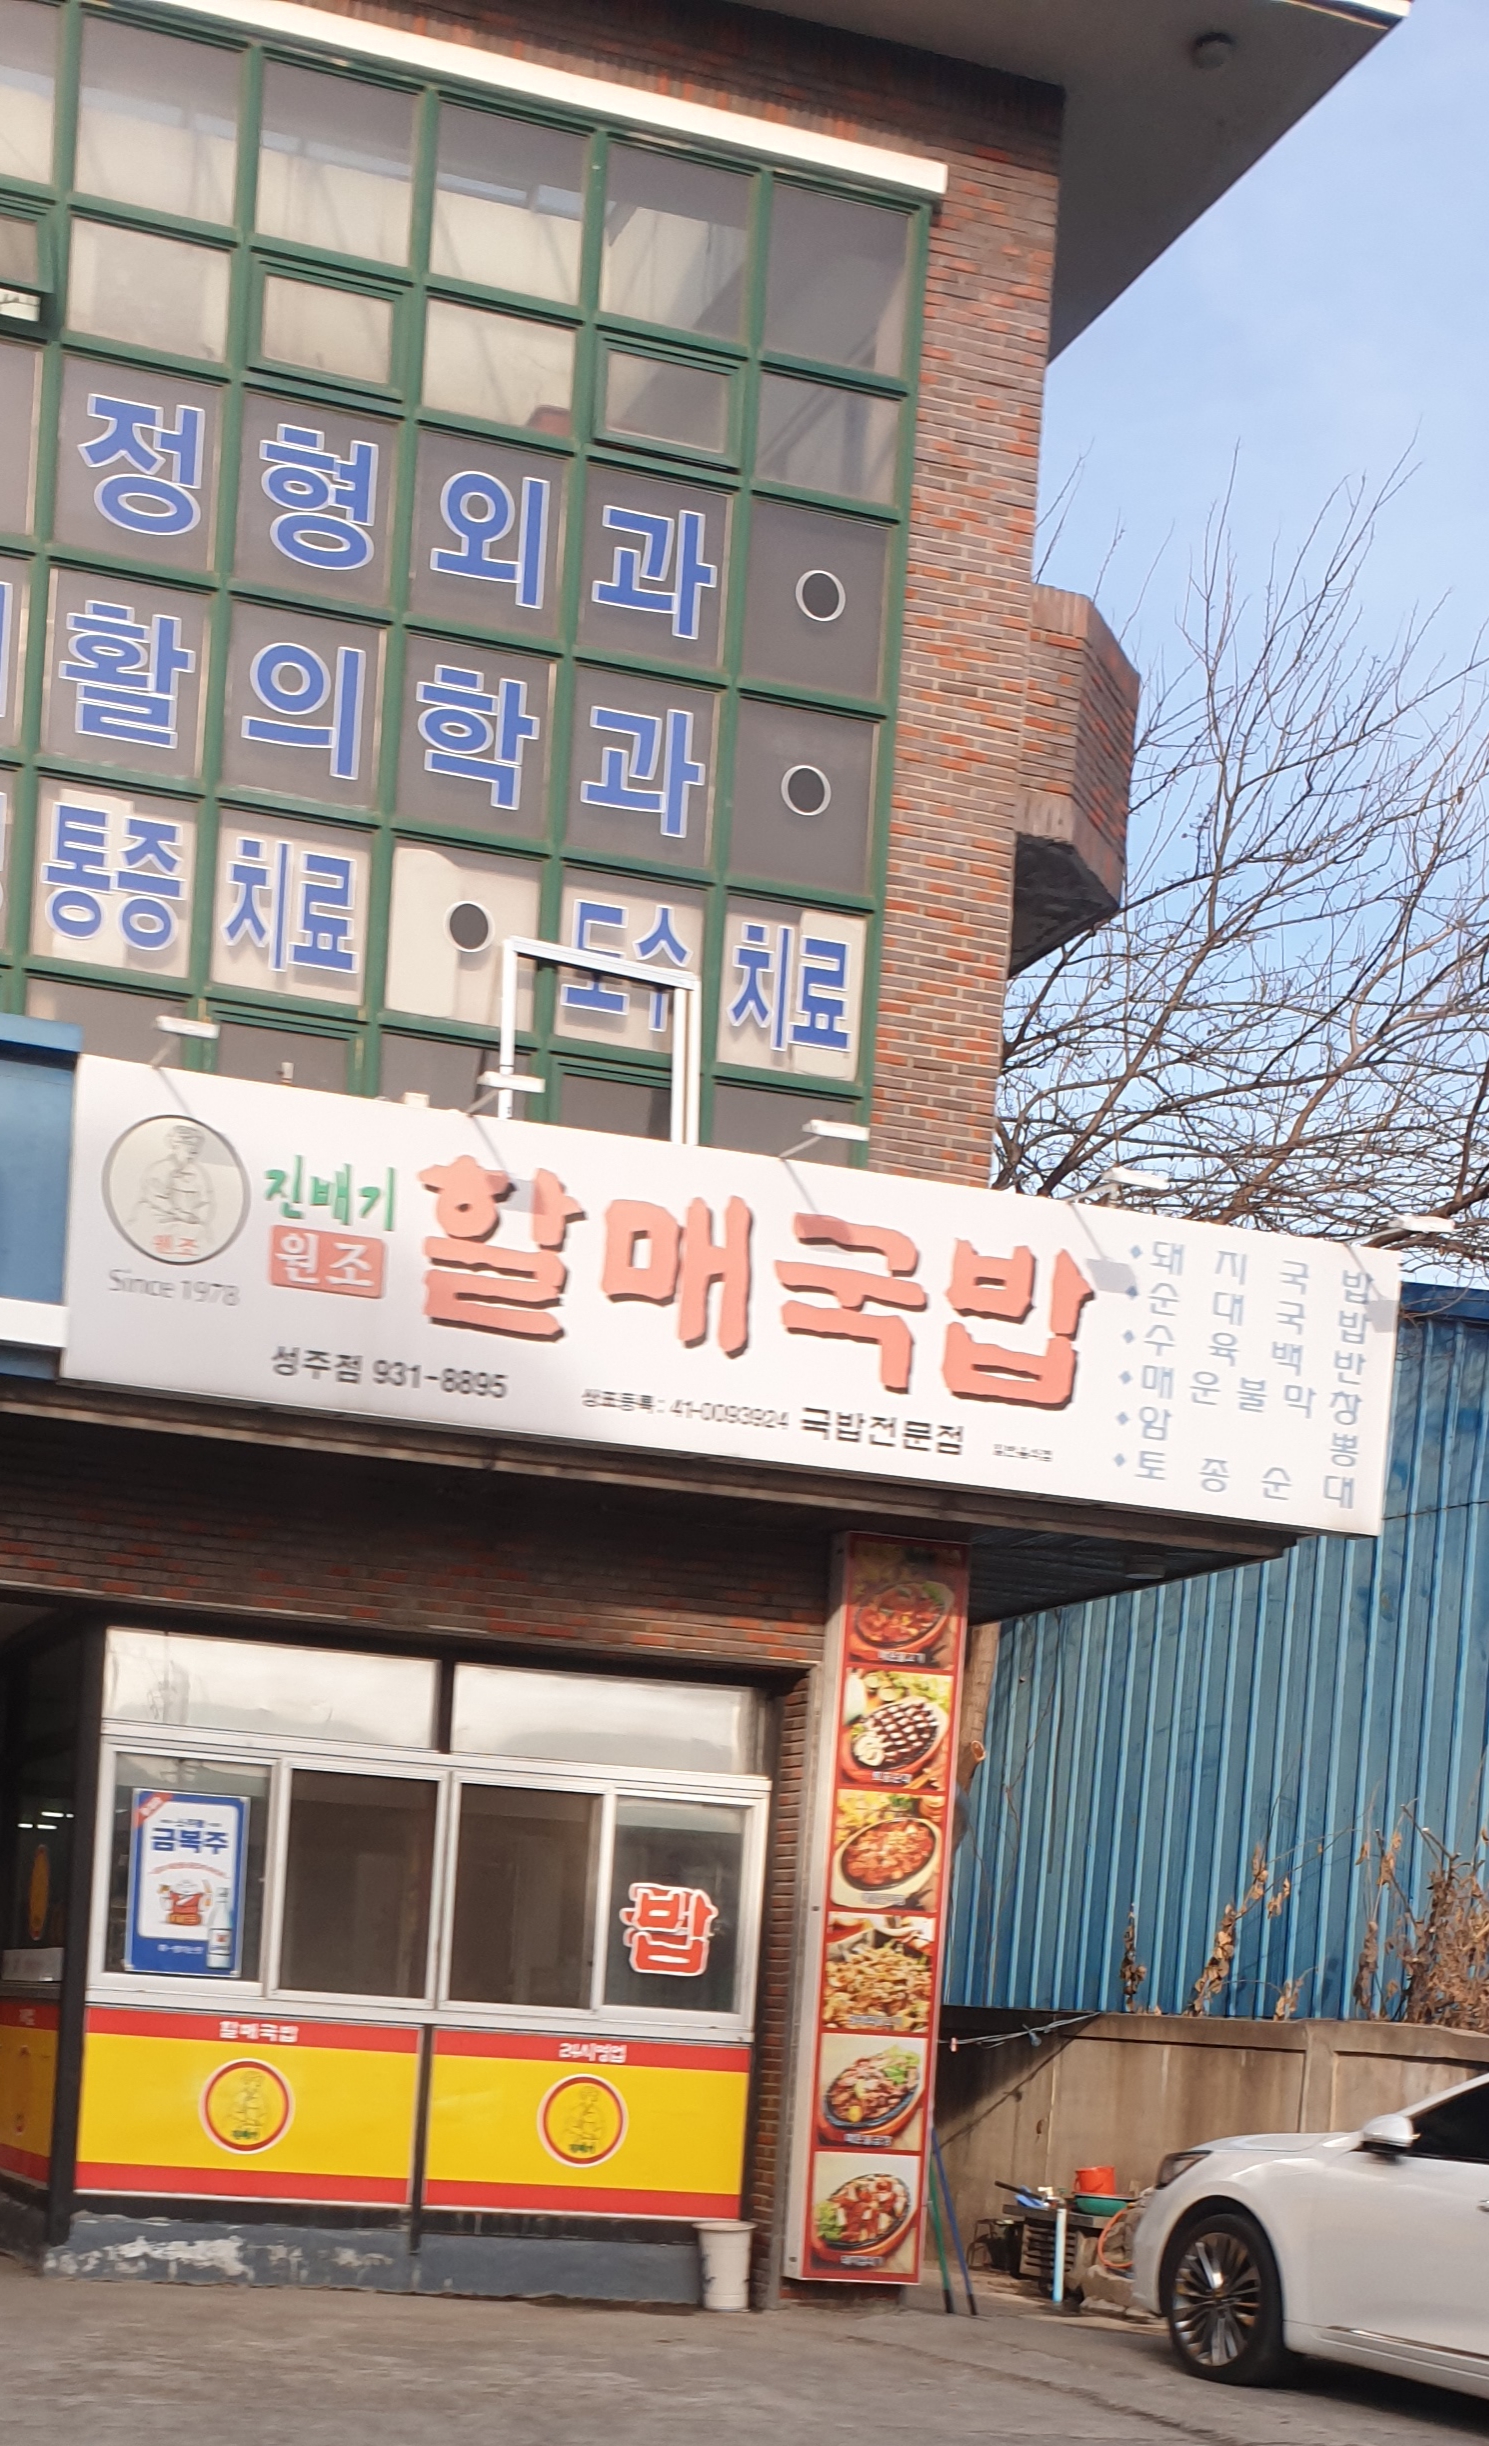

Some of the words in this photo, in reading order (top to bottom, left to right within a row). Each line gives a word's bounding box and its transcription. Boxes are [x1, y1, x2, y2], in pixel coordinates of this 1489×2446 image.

[77, 393, 717, 640] 정형외과
[0, 581, 706, 839] 활의학과
[0, 791, 359, 974] 통증치료
[264, 1154, 395, 1232] 진배기
[108, 1268, 175, 1299] Since
[180, 1279, 241, 1306] 1978
[274, 1231, 377, 1288] 원조
[417, 1154, 1096, 1411] 할매국밥
[271, 1345, 364, 1385] 성주점
[371, 1358, 508, 1399] 931-8895
[799, 1407, 965, 1455] 국밥전문점
[150, 1827, 230, 1855] 금복주
